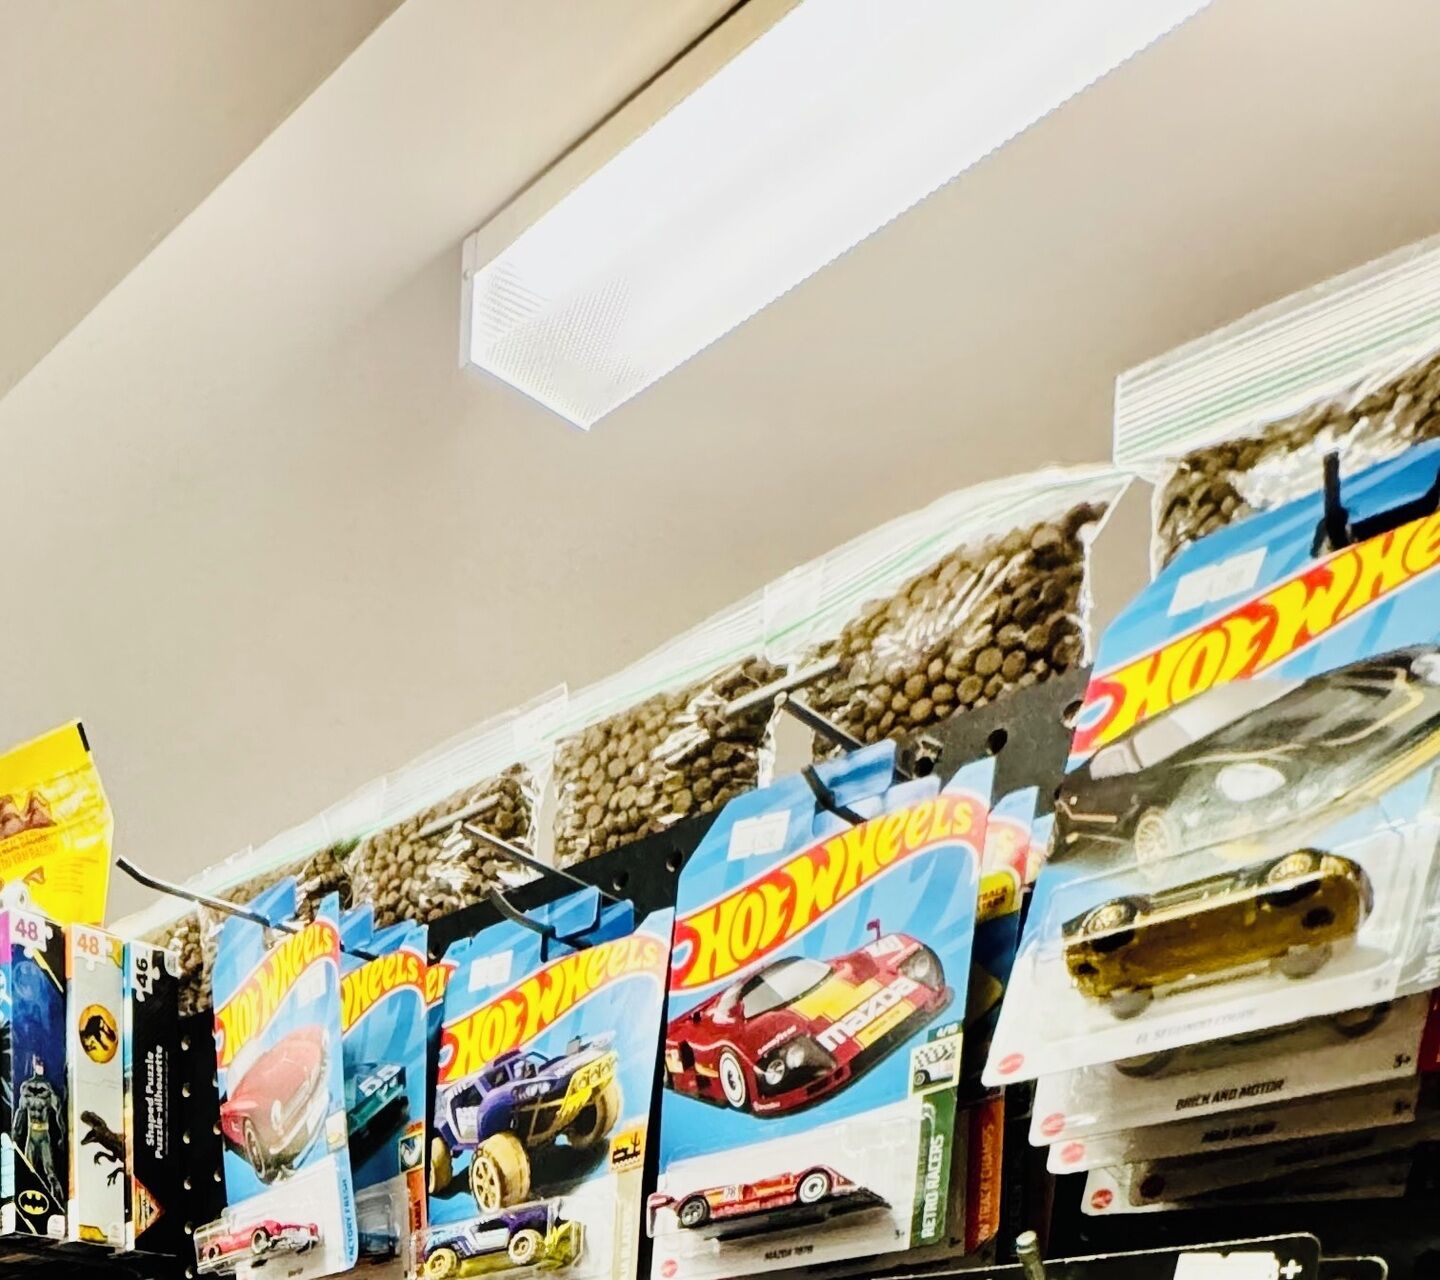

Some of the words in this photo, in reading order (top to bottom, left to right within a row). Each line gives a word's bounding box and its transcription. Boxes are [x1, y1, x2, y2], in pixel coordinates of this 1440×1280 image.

[1091, 617, 1269, 748] HOT
[1253, 512, 1440, 674] WHE
[679, 883, 790, 988] HOT
[781, 798, 973, 940] WHEELS
[15, 917, 40, 942] 48
[77, 932, 101, 956] 48
[258, 924, 334, 1034] WHEELS
[443, 998, 525, 1083] HOT
[521, 939, 660, 1046] WHEELS
[1175, 1091, 1211, 1112] BRICK
[1211, 1086, 1237, 1104] AND
[1239, 1078, 1285, 1099] MOTOR
[926, 1134, 946, 1183] RACERS
[920, 1184, 941, 1239] RETRO
